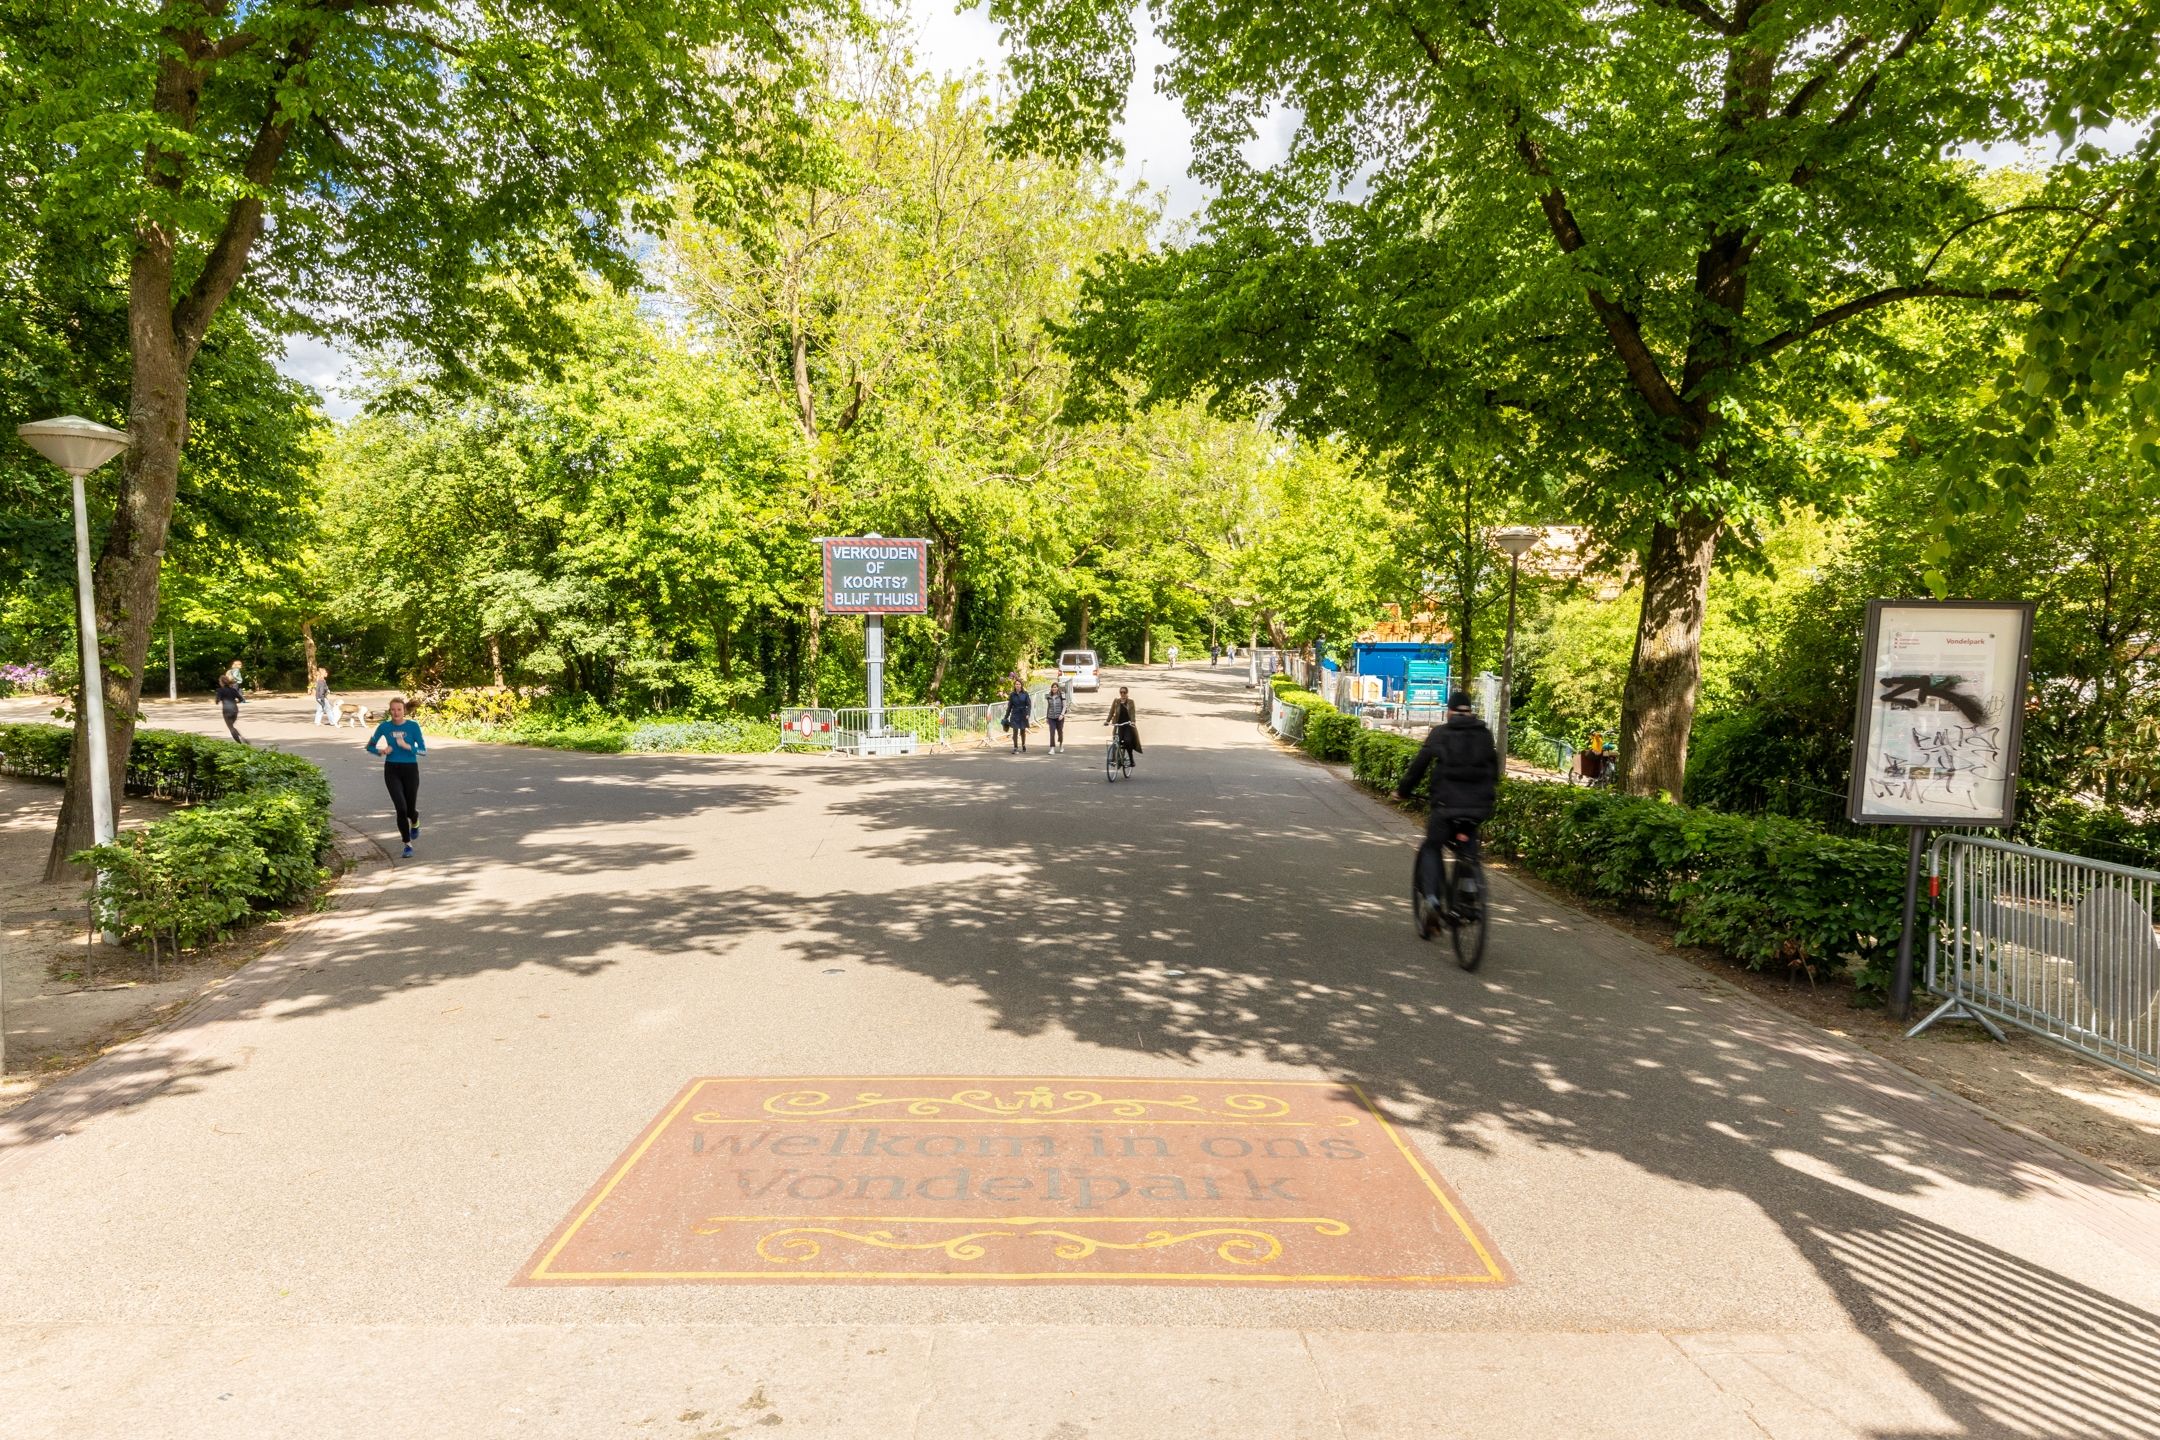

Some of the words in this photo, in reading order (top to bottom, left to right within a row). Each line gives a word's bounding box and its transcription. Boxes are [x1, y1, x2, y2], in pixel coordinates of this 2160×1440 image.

[832, 546, 918, 560] VERKOUDEN
[866, 561, 885, 574] OF
[843, 576, 908, 588] KOORTS?
[834, 593, 870, 605] BLIJF
[874, 593, 918, 605] THUIS!
[1946, 638, 1985, 646] Vondelpark
[692, 1127, 1058, 1159] Welkom
[1091, 1129, 1176, 1158] in
[1200, 1135, 1366, 1160] ons
[731, 1167, 1304, 1210] Vondelpark
